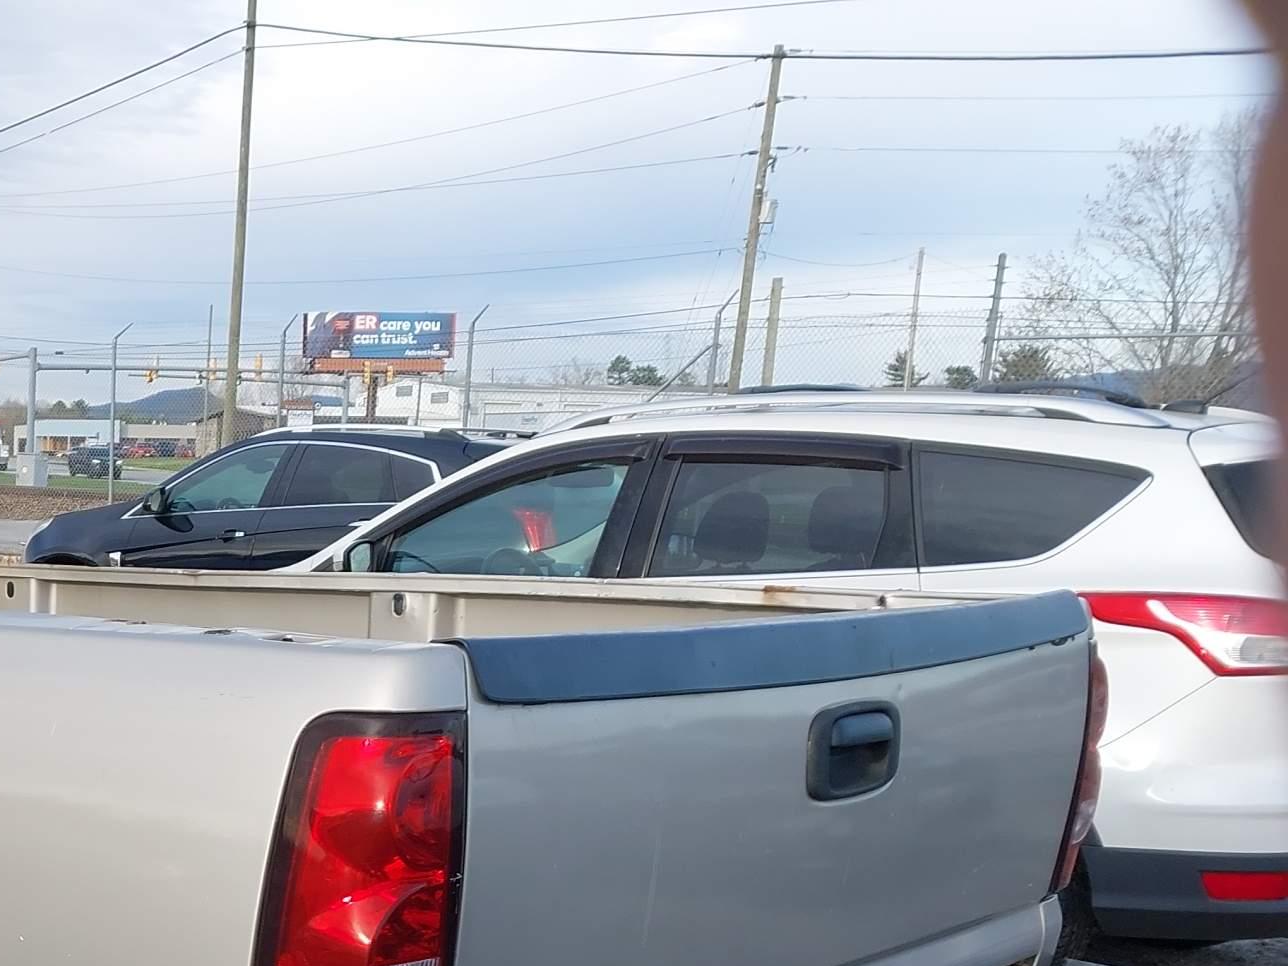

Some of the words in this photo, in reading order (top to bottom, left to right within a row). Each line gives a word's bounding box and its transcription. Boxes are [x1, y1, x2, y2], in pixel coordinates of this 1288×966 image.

[354, 315, 377, 329] ER
[379, 320, 411, 331] care
[414, 320, 441, 334] you
[353, 333, 378, 344] can
[380, 332, 417, 344] trust.
